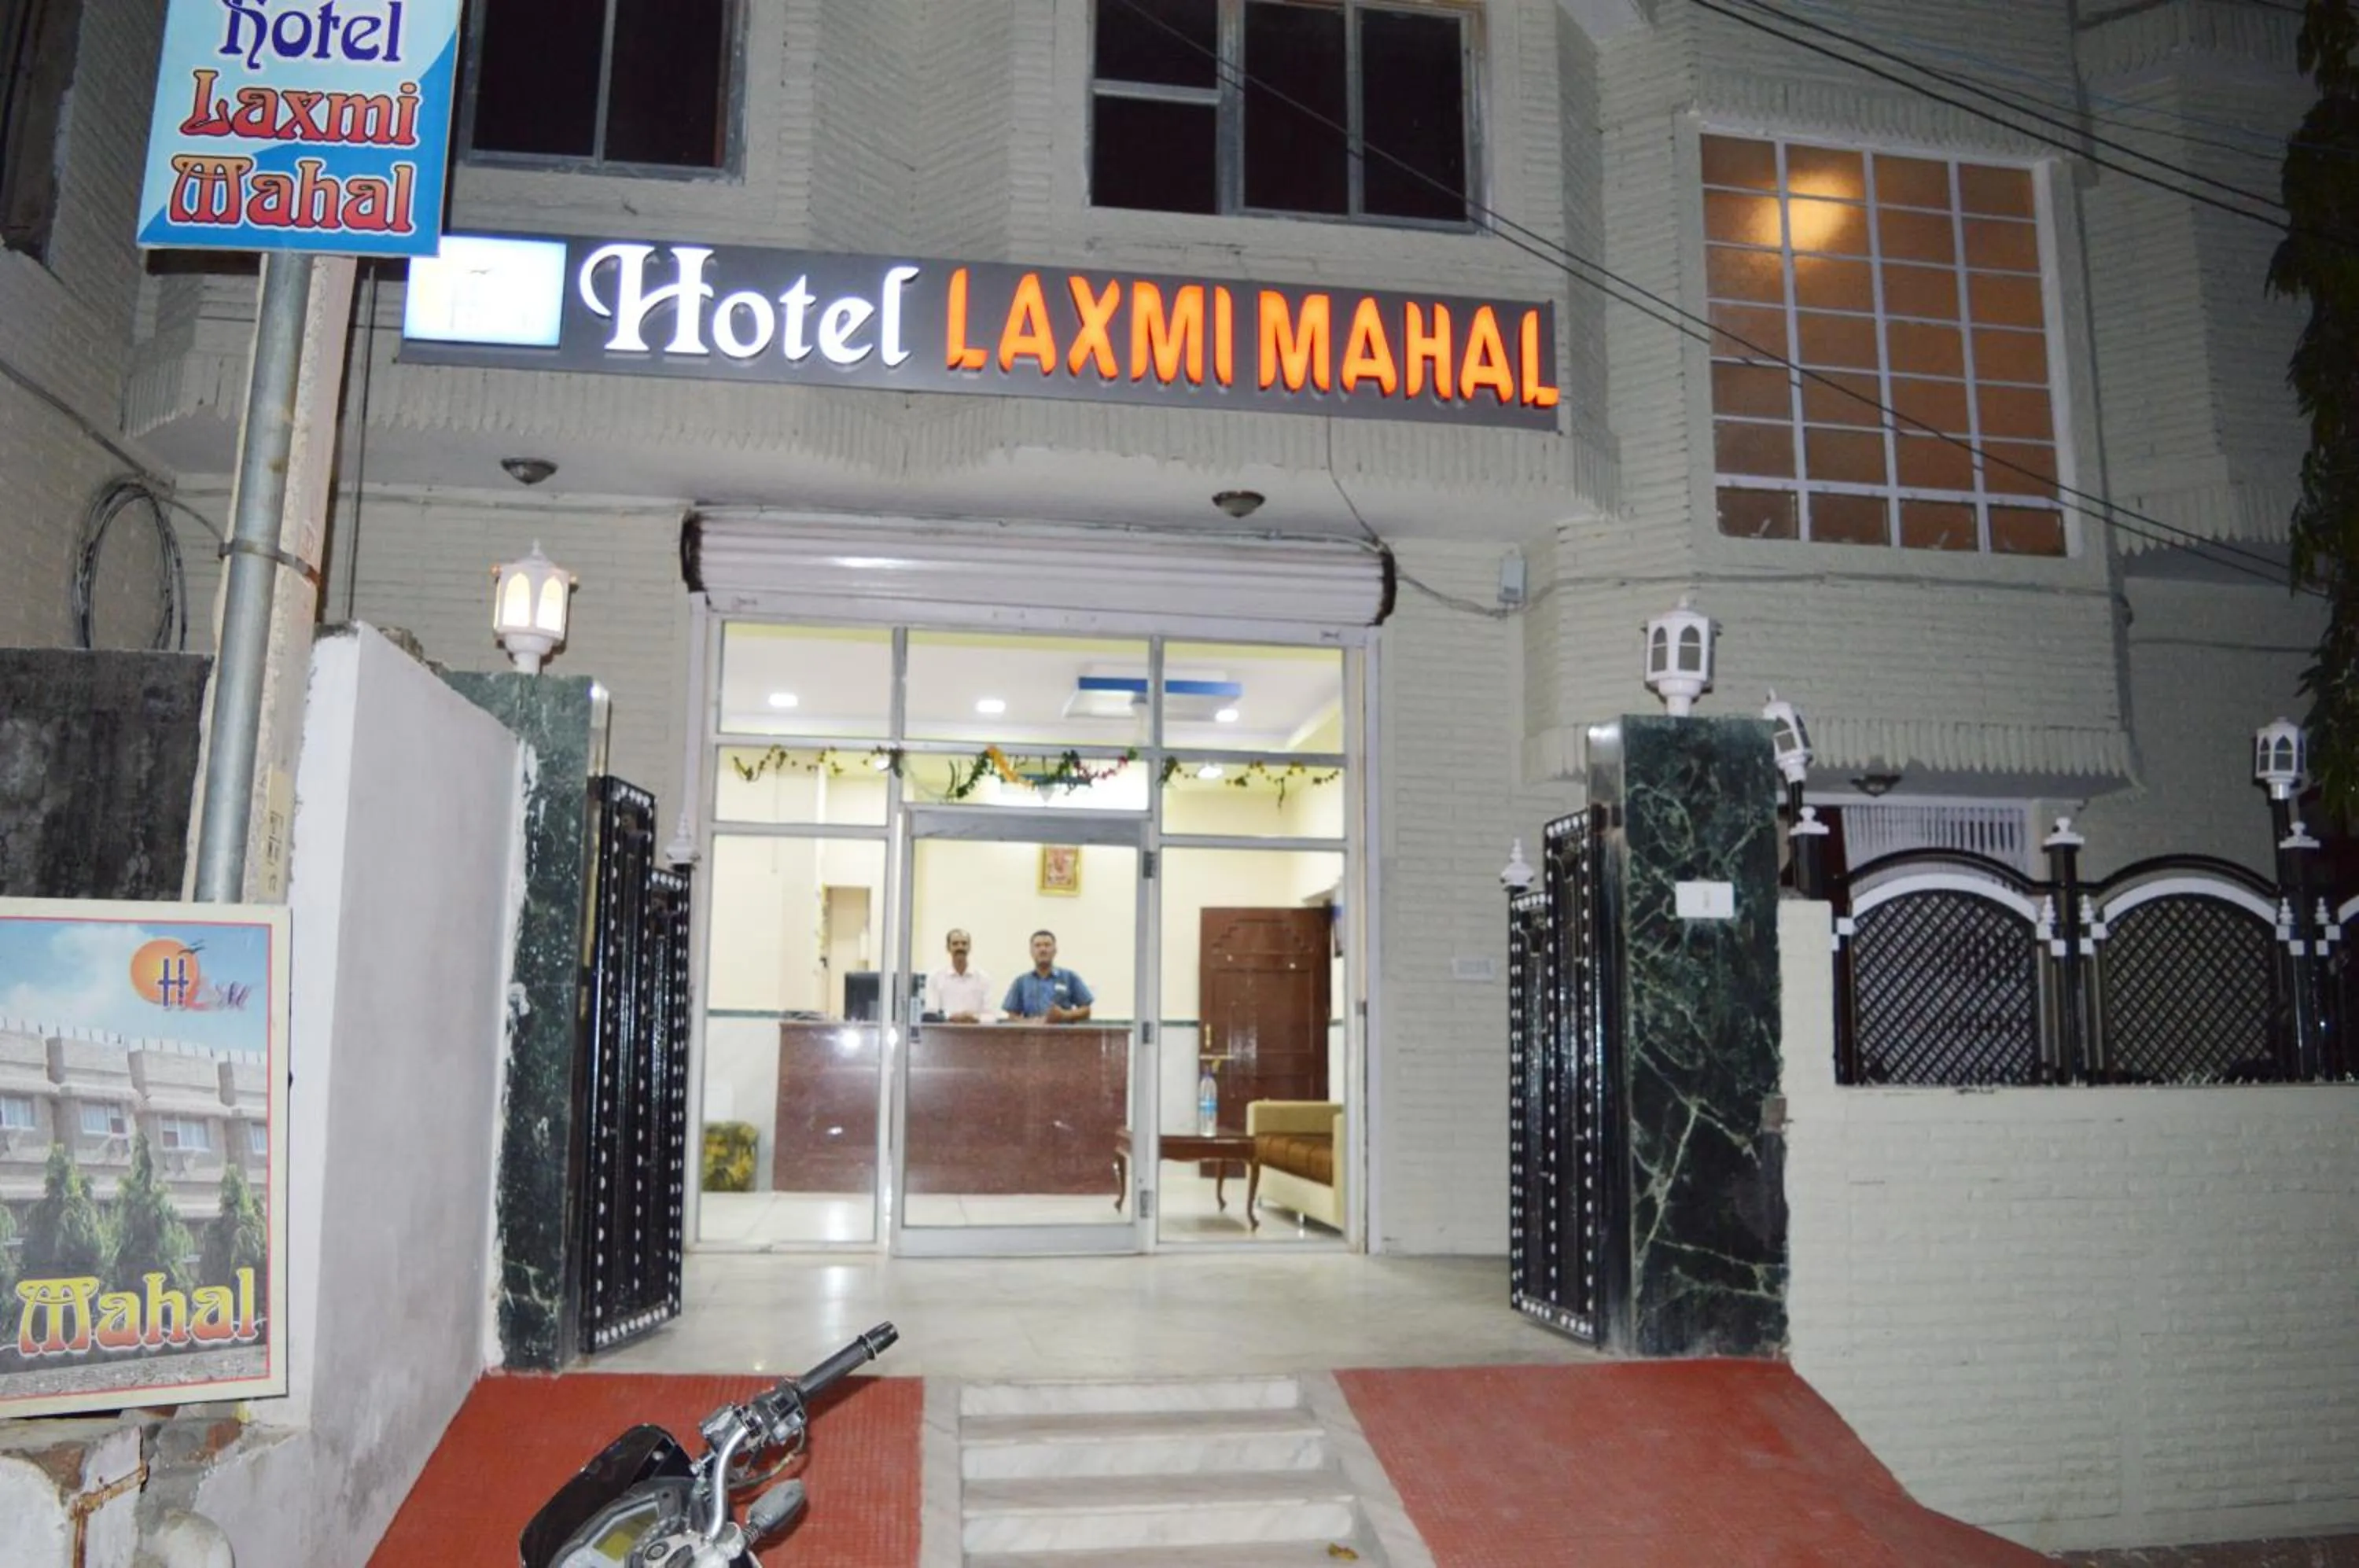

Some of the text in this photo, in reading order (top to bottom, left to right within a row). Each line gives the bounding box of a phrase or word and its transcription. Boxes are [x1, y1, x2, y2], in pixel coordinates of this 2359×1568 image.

[179, 68, 419, 145] Laxmi
[168, 155, 415, 233] Mahal
[578, 244, 920, 367] Hotel
[947, 267, 1233, 387] LAXMI
[1258, 289, 1560, 407] MAHAL
[15, 1267, 259, 1357] Mahal
